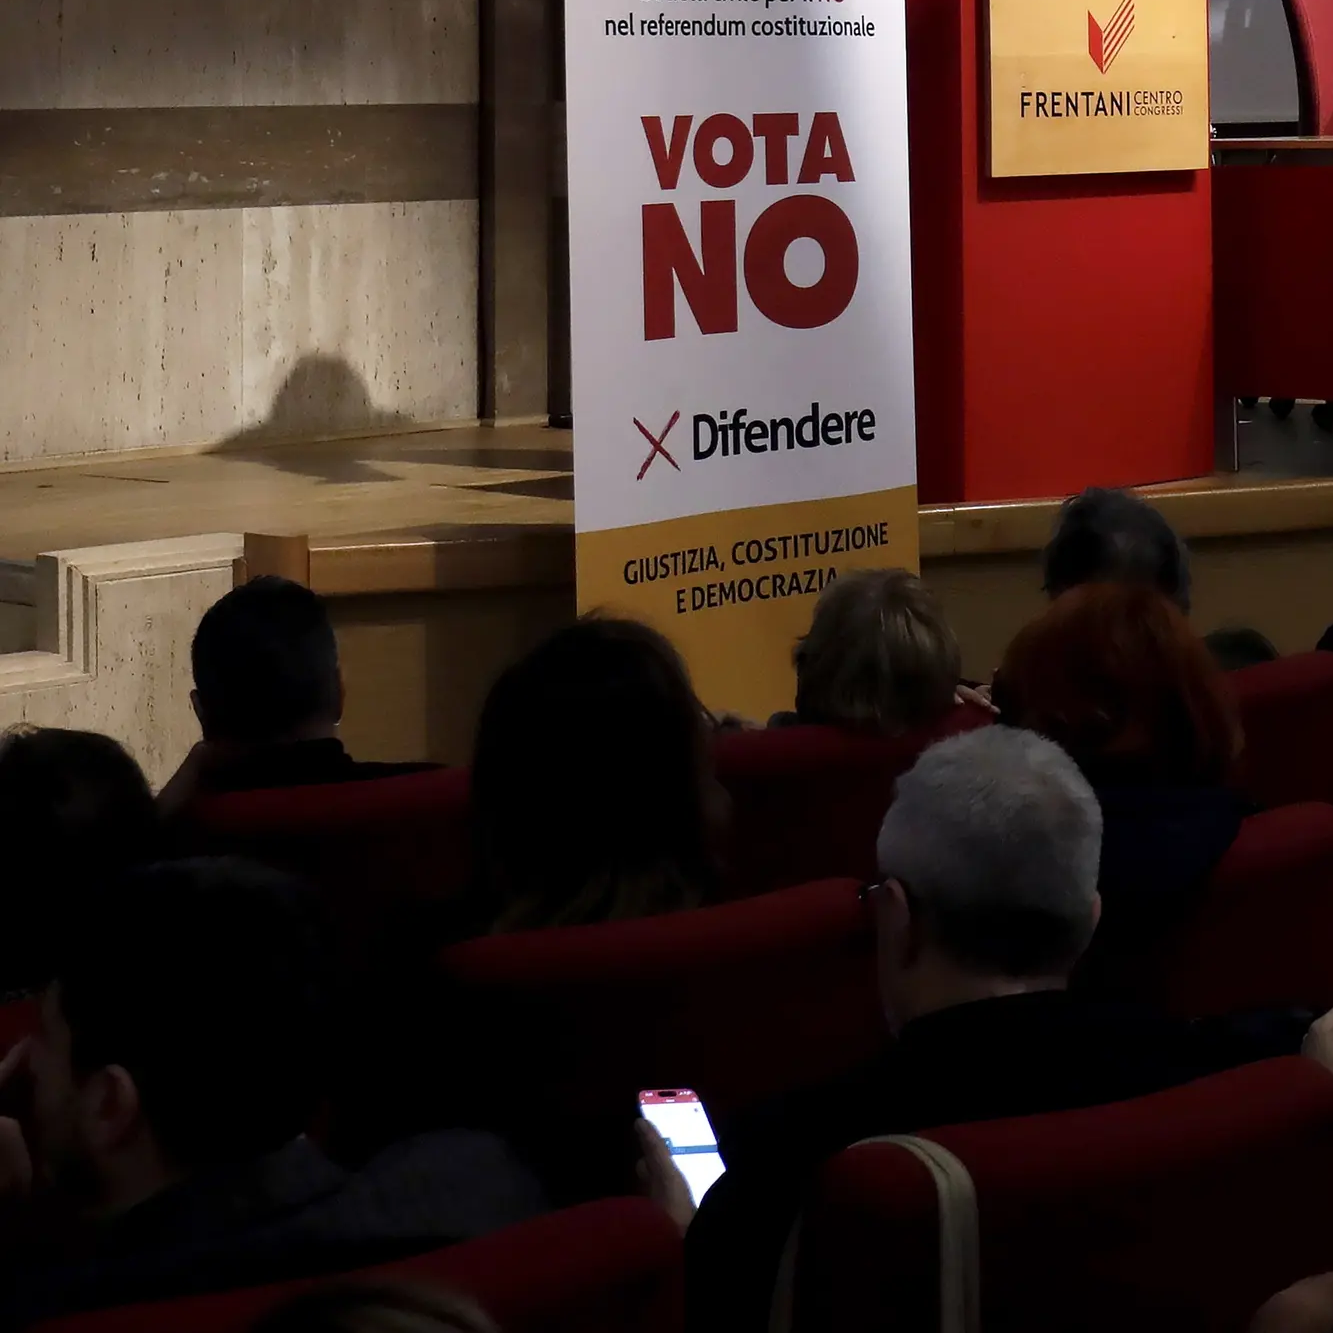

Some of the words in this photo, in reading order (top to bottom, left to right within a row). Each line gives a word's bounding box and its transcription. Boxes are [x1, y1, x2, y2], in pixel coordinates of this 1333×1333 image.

[605, 12, 635, 36] nel
[640, 13, 746, 36] referendum
[751, 16, 875, 37] costituzionale
[1020, 91, 1131, 118] FRENTANI
[1134, 90, 1183, 105] CENTRO
[1134, 105, 1183, 116] CONGRESSI
[640, 112, 855, 190] VOTA
[642, 194, 860, 341] NO
[692, 402, 876, 461] Difendere
[624, 545, 725, 585] GIUSTIZIA,
[731, 522, 889, 566] COSTITUZIONE
[676, 589, 687, 613] E
[692, 567, 837, 611] DEMOCRAZIA
